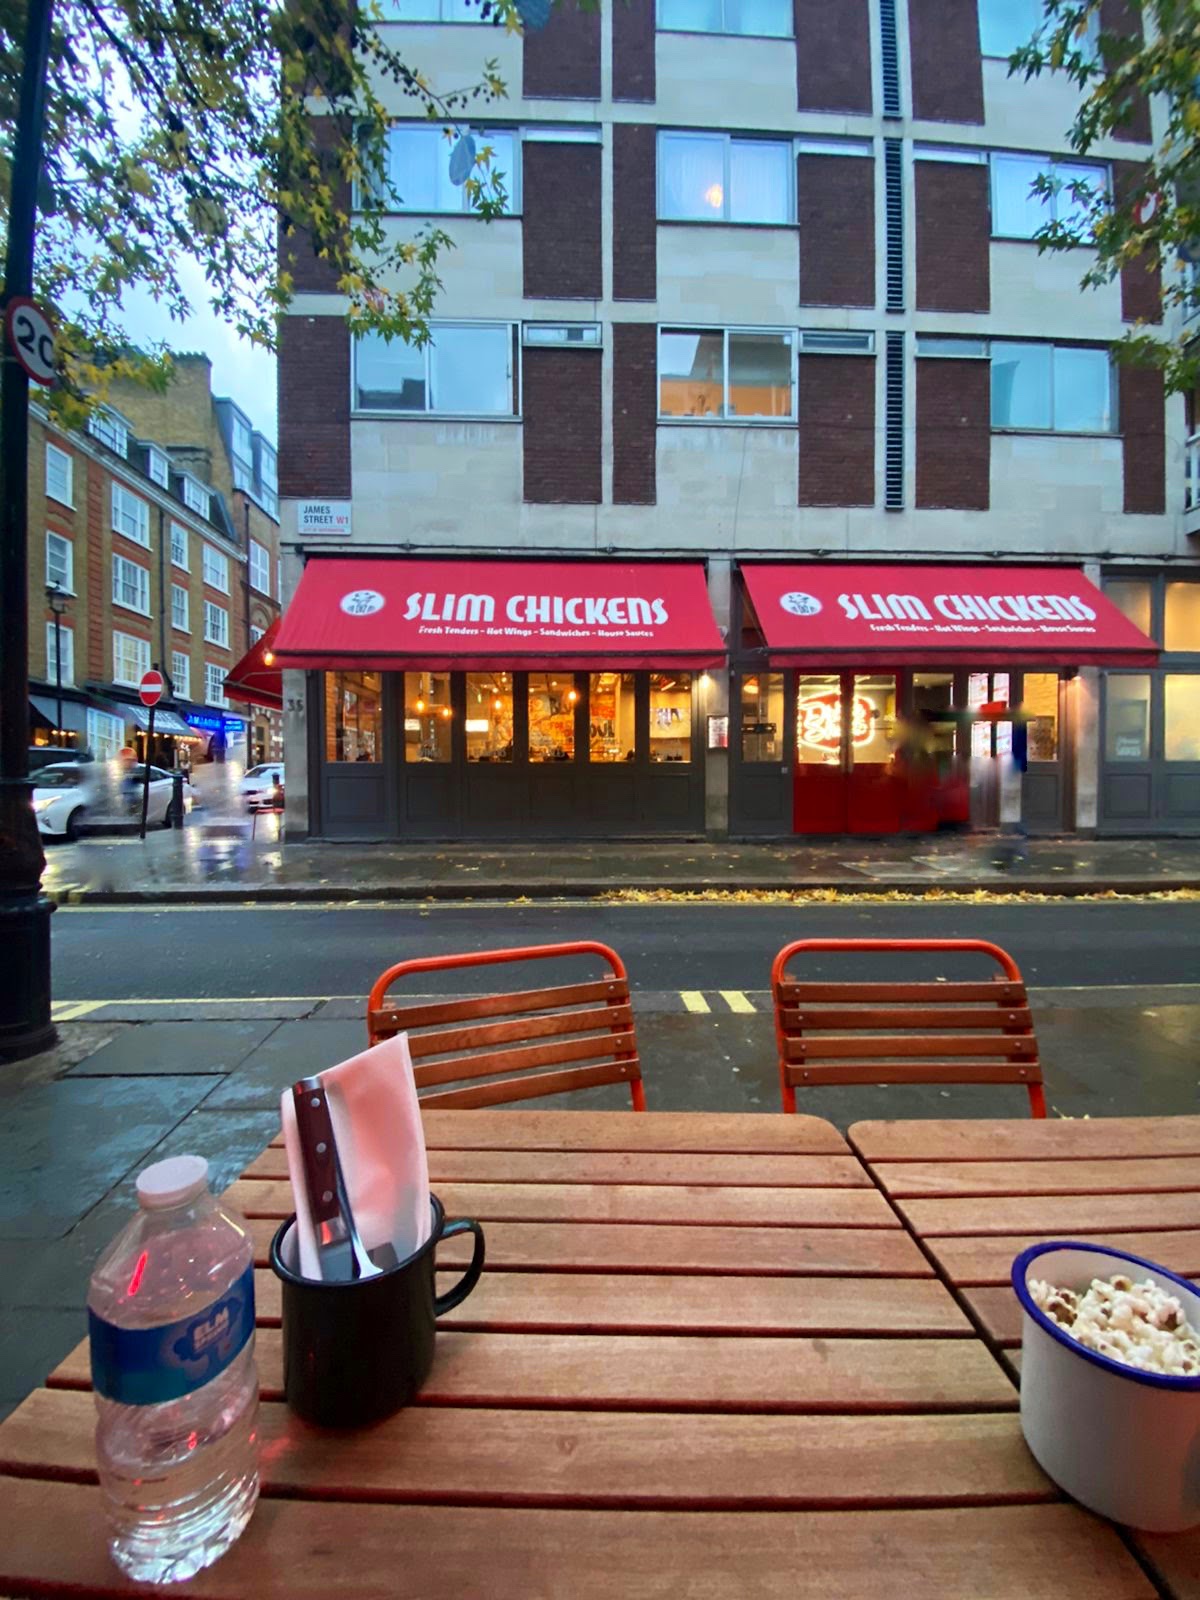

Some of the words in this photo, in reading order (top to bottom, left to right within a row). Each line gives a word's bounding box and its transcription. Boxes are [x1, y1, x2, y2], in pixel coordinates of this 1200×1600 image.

[303, 505, 331, 514] JAMES
[303, 515, 334, 524] STREET
[336, 516, 349, 524] W1
[402, 592, 496, 622] SLIM
[505, 595, 669, 625] CHICKENS
[837, 594, 933, 620] SLIM
[934, 594, 1097, 621] CHICKENS
[418, 625, 443, 635] Fresh
[444, 626, 479, 636] Tenders
[486, 627, 503, 636] Hot
[504, 627, 533, 637] Wings
[539, 628, 591, 637] Sandwiches
[597, 629, 624, 637] House
